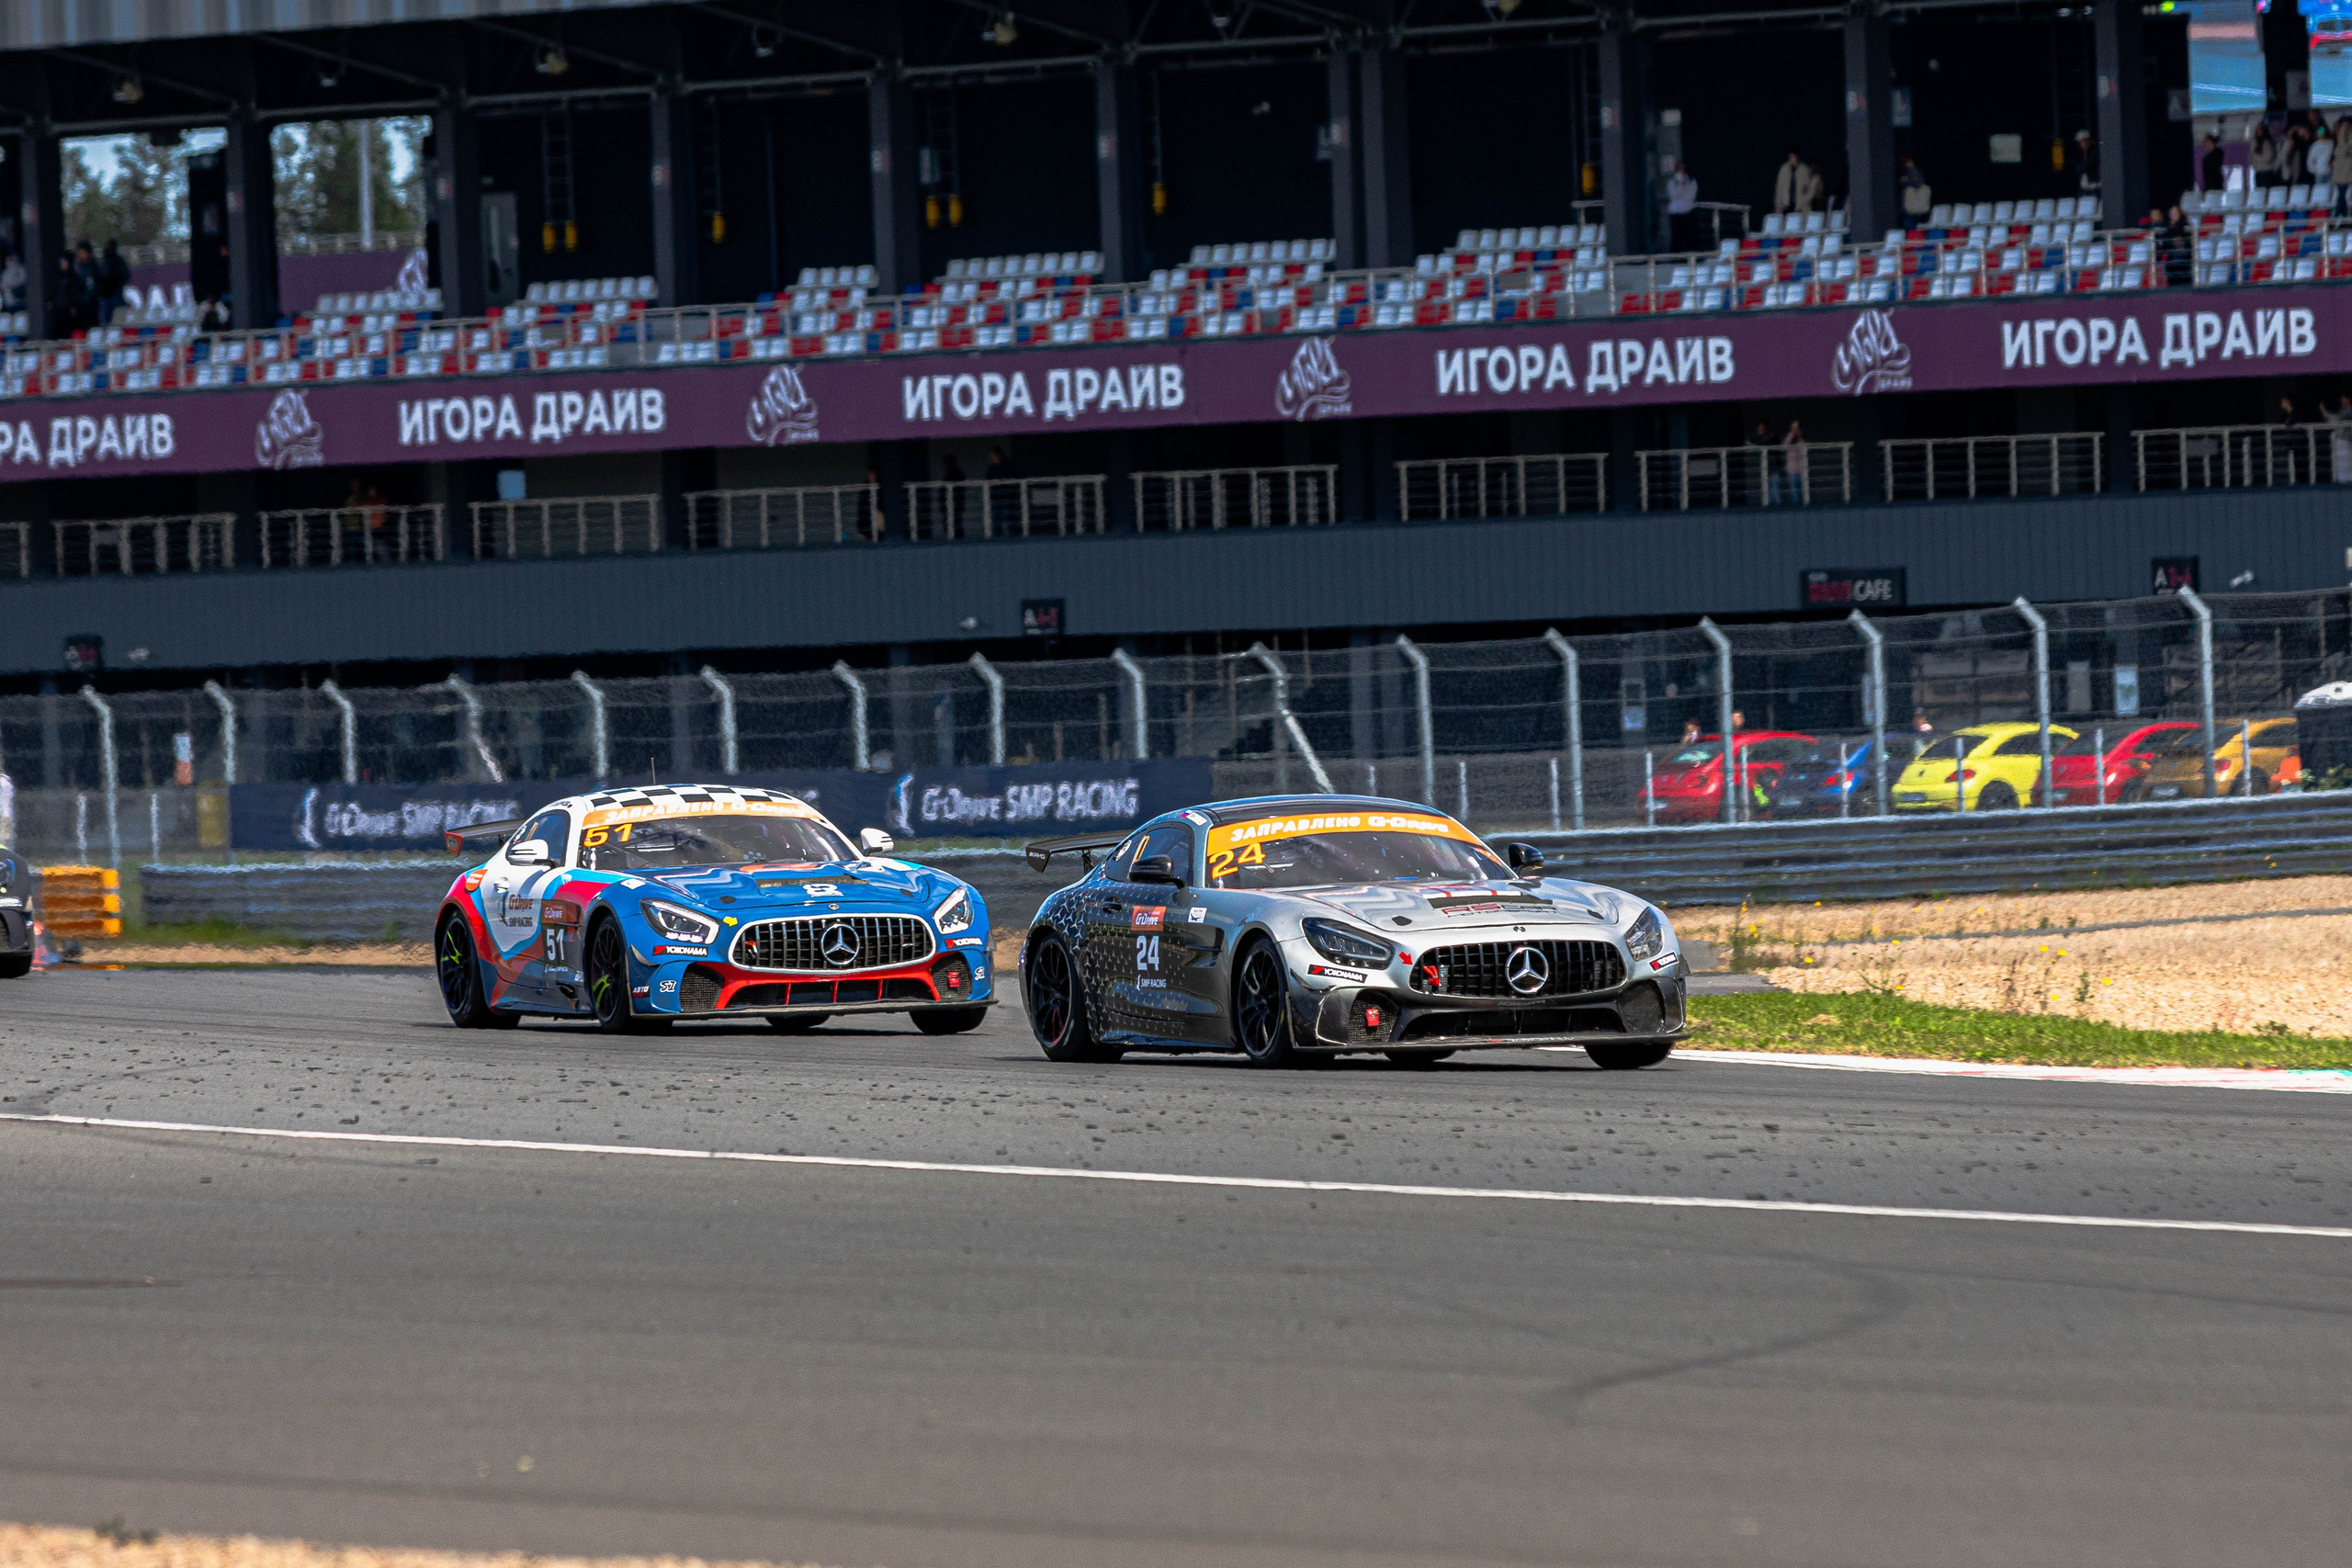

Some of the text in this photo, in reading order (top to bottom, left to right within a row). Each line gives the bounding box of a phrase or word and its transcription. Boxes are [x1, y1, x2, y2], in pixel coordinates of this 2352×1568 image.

[2002, 308, 2318, 369] ИГОРА ДРАЙВ
[1436, 343, 1577, 396] ИГОРА
[902, 371, 1035, 421] ИГОРА
[400, 393, 524, 446] ИГОРА
[1853, 579, 1893, 602] CAFE
[1005, 784, 1054, 820] SMP
[1056, 778, 1139, 819] RACING
[583, 823, 633, 848] 51
[1230, 817, 1362, 841] ЗАПРАВЛЕНО
[1208, 842, 1266, 879] 24
[547, 929, 565, 961] 51
[665, 945, 707, 956] YOKOHAMA
[1136, 935, 1159, 971] 24
[1140, 978, 1167, 987] SMP RACING
[1324, 967, 1363, 982] YOKOHAMA
